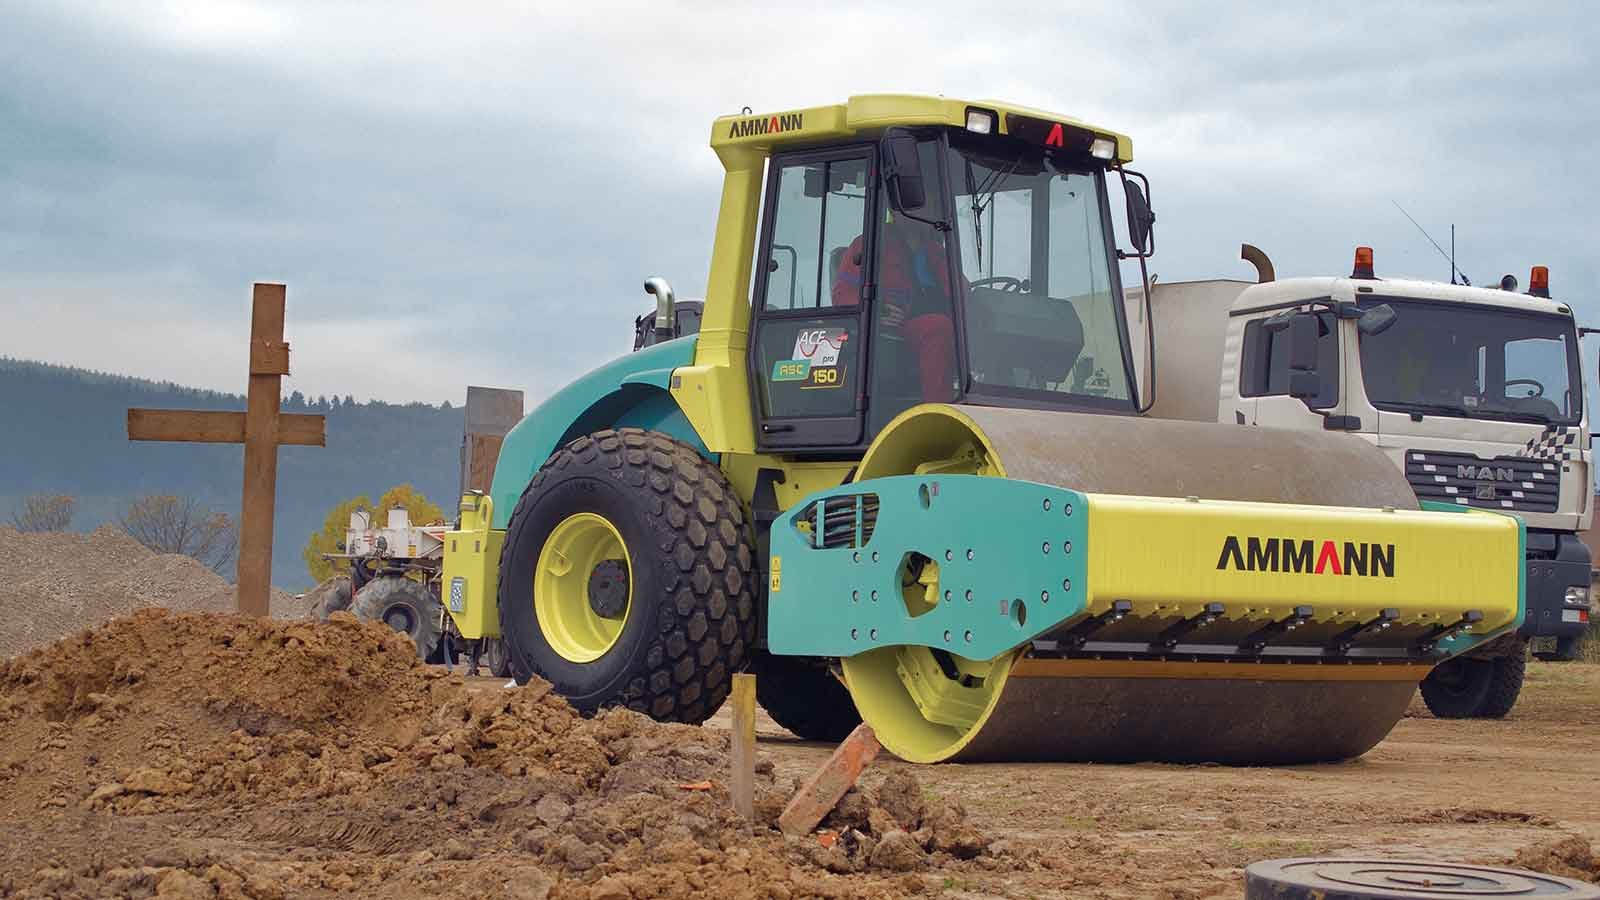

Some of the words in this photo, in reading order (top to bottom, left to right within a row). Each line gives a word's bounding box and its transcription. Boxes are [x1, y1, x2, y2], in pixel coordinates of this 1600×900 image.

[729, 114, 803, 138] AMMANN
[800, 330, 827, 345] ACE
[822, 355, 835, 365] pro
[813, 369, 837, 383] 150
[1457, 464, 1514, 481] MAN
[1216, 536, 1395, 577] AMMANN
